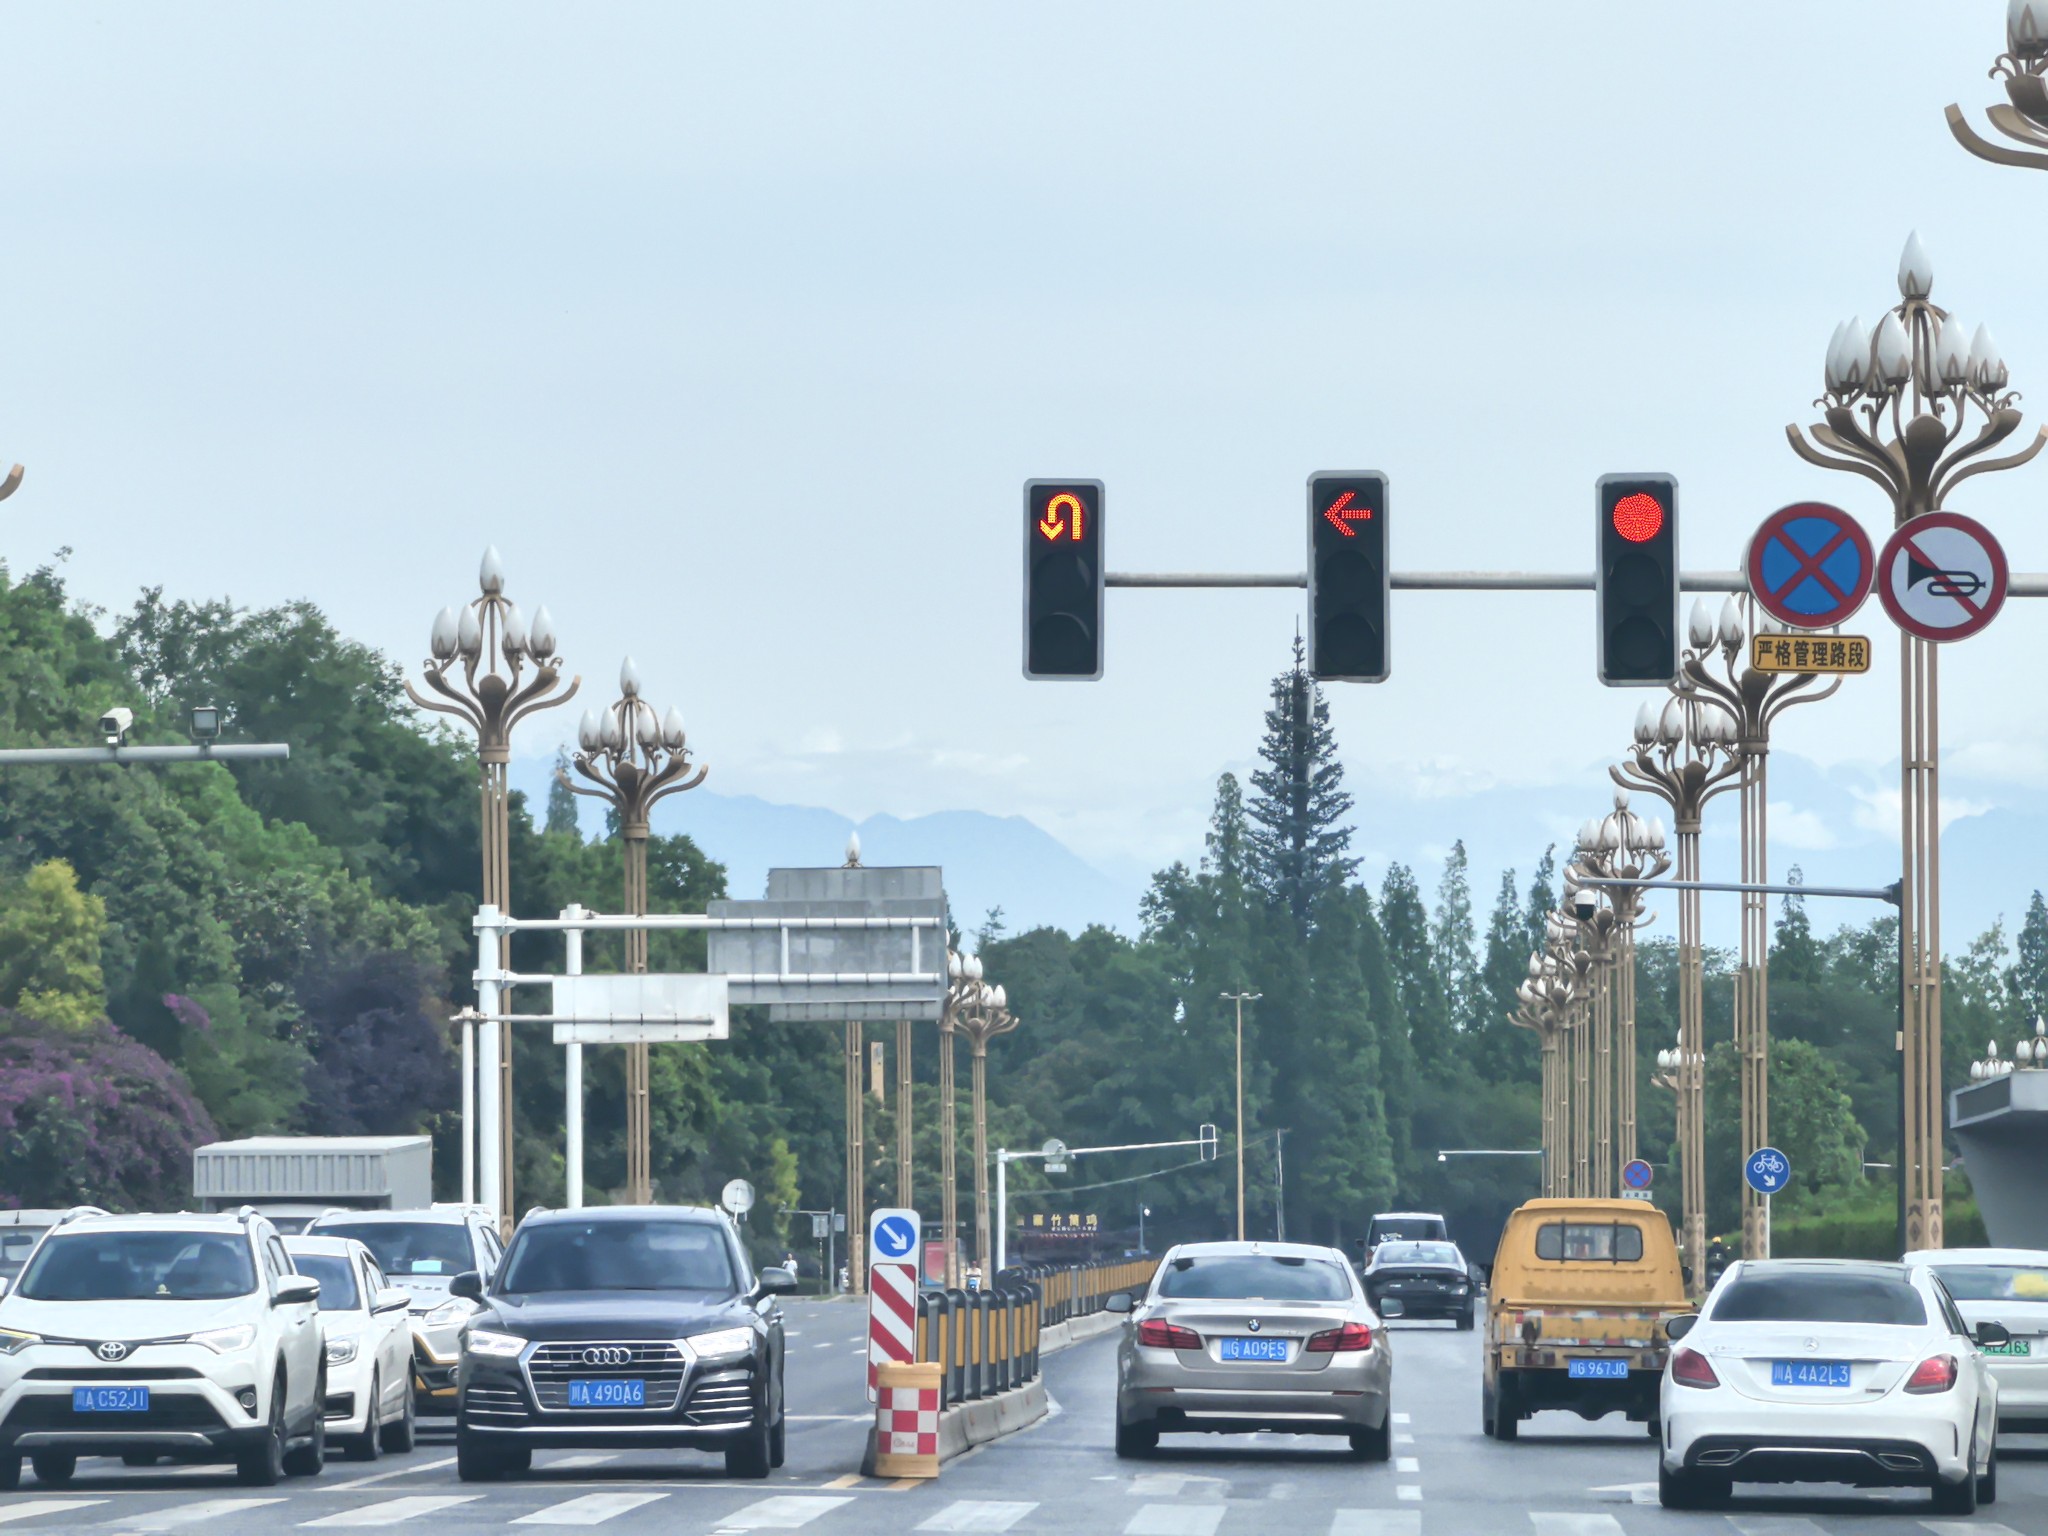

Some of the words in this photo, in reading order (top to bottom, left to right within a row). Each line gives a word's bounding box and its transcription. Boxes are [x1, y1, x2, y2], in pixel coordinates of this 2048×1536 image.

[1757, 640, 1865, 667] 严格管理路段
